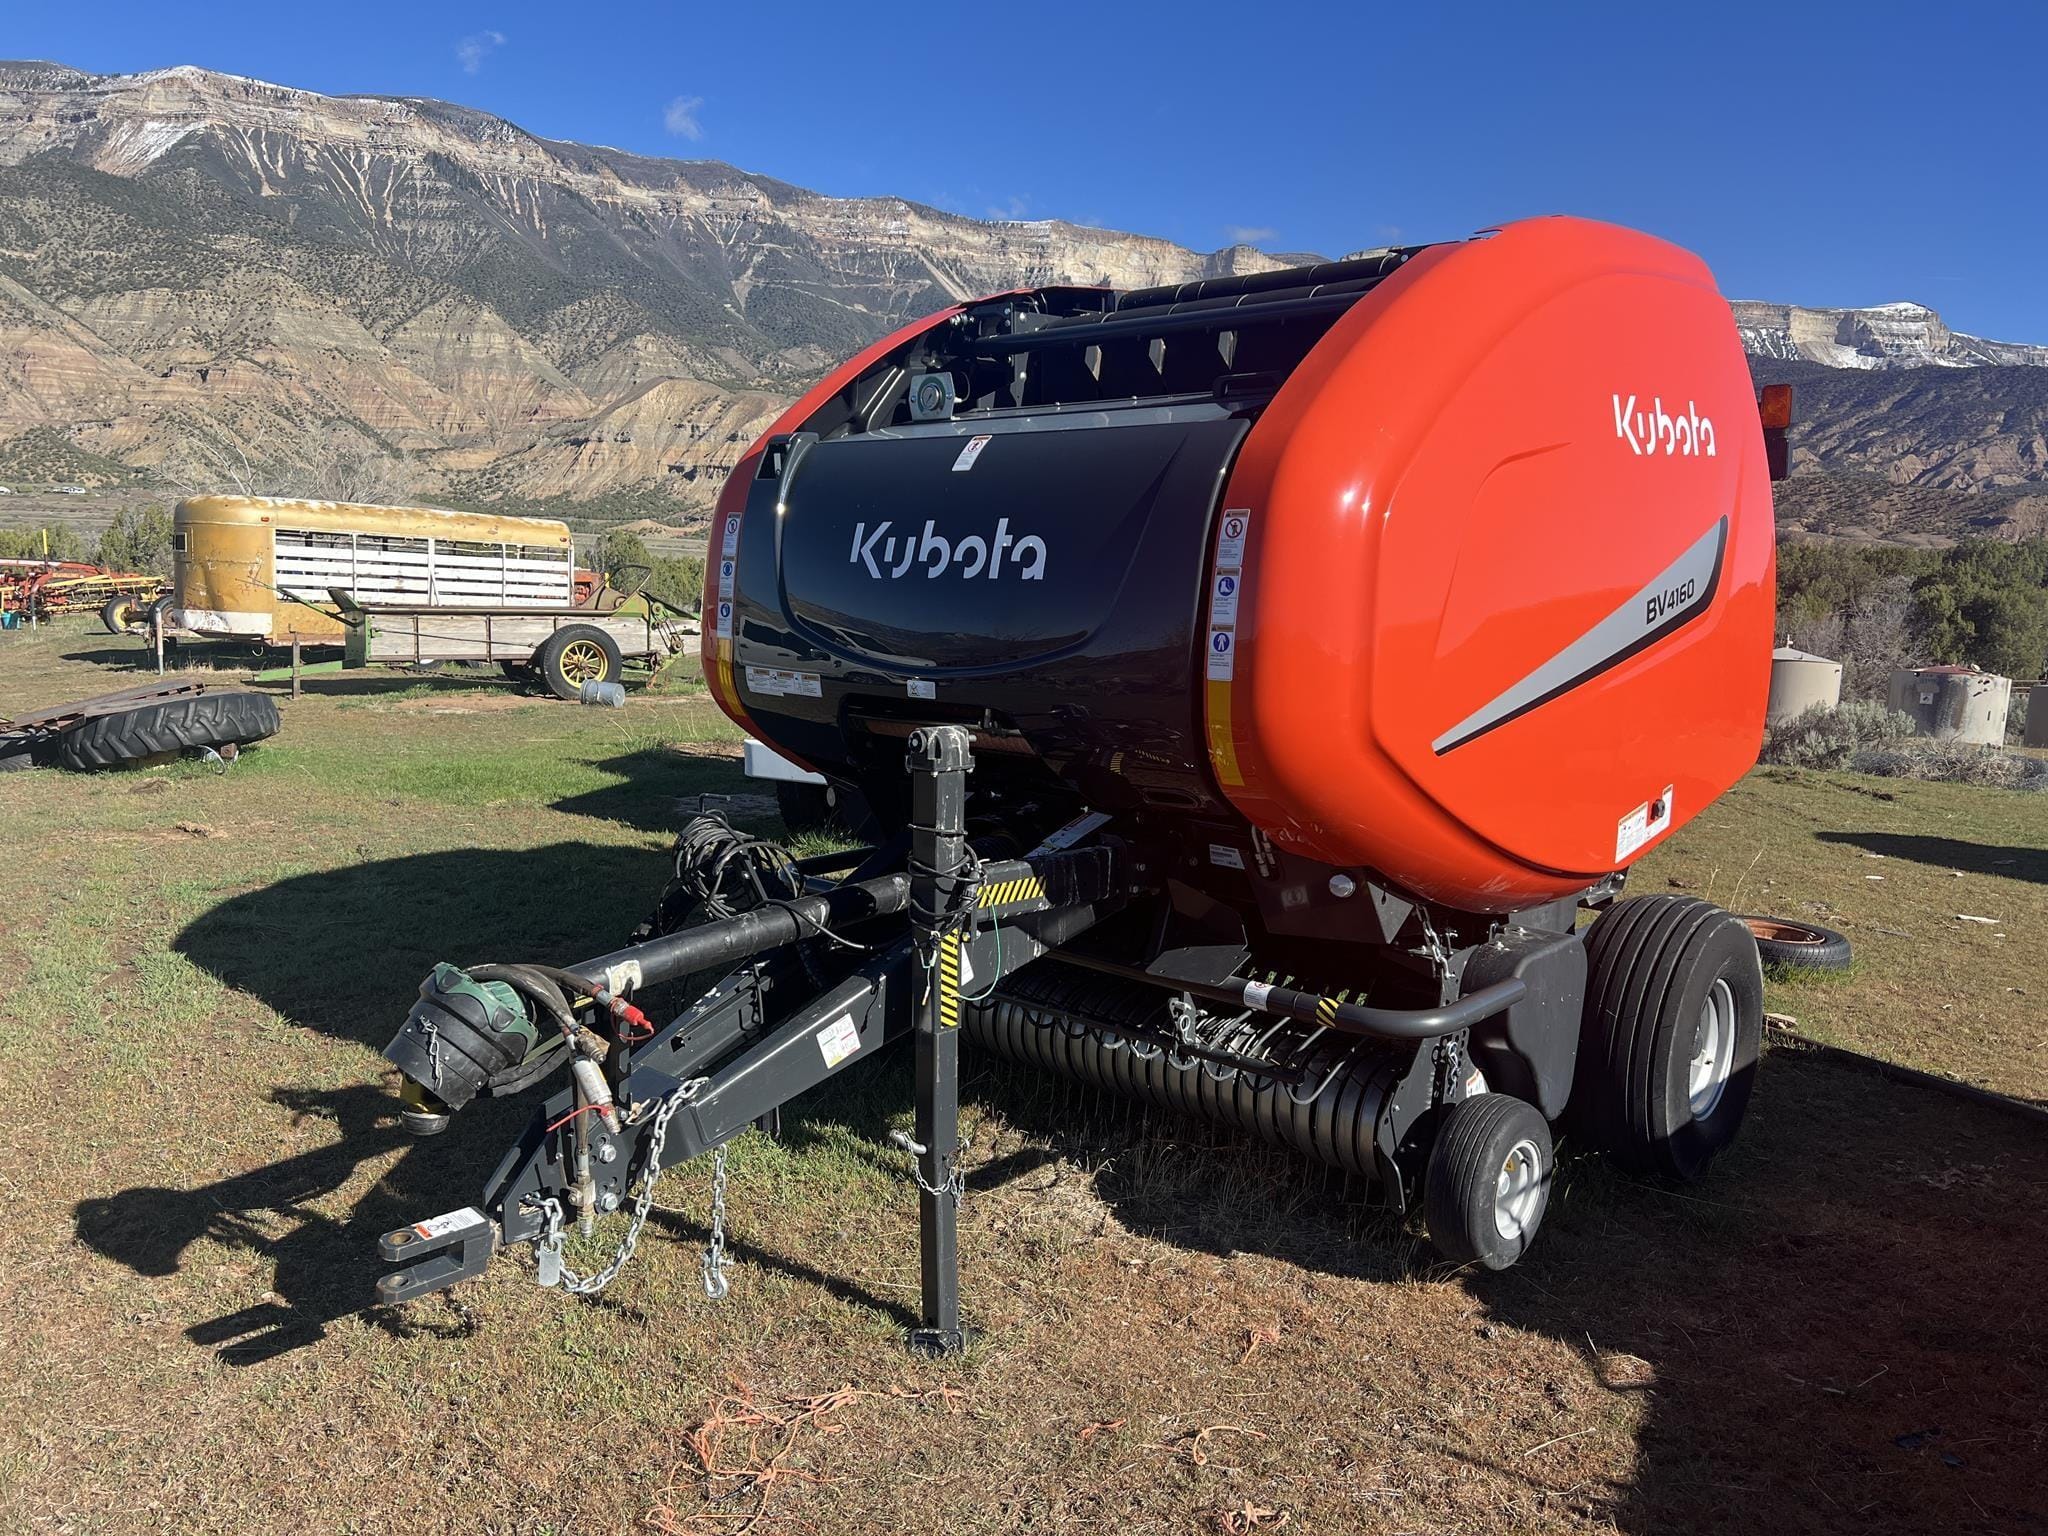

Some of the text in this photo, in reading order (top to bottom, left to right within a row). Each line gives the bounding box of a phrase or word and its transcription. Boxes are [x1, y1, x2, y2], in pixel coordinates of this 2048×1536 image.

[1612, 394, 1716, 456] Kubota
[850, 517, 1047, 580] Kubota
[1646, 578, 1695, 625] BV4160
